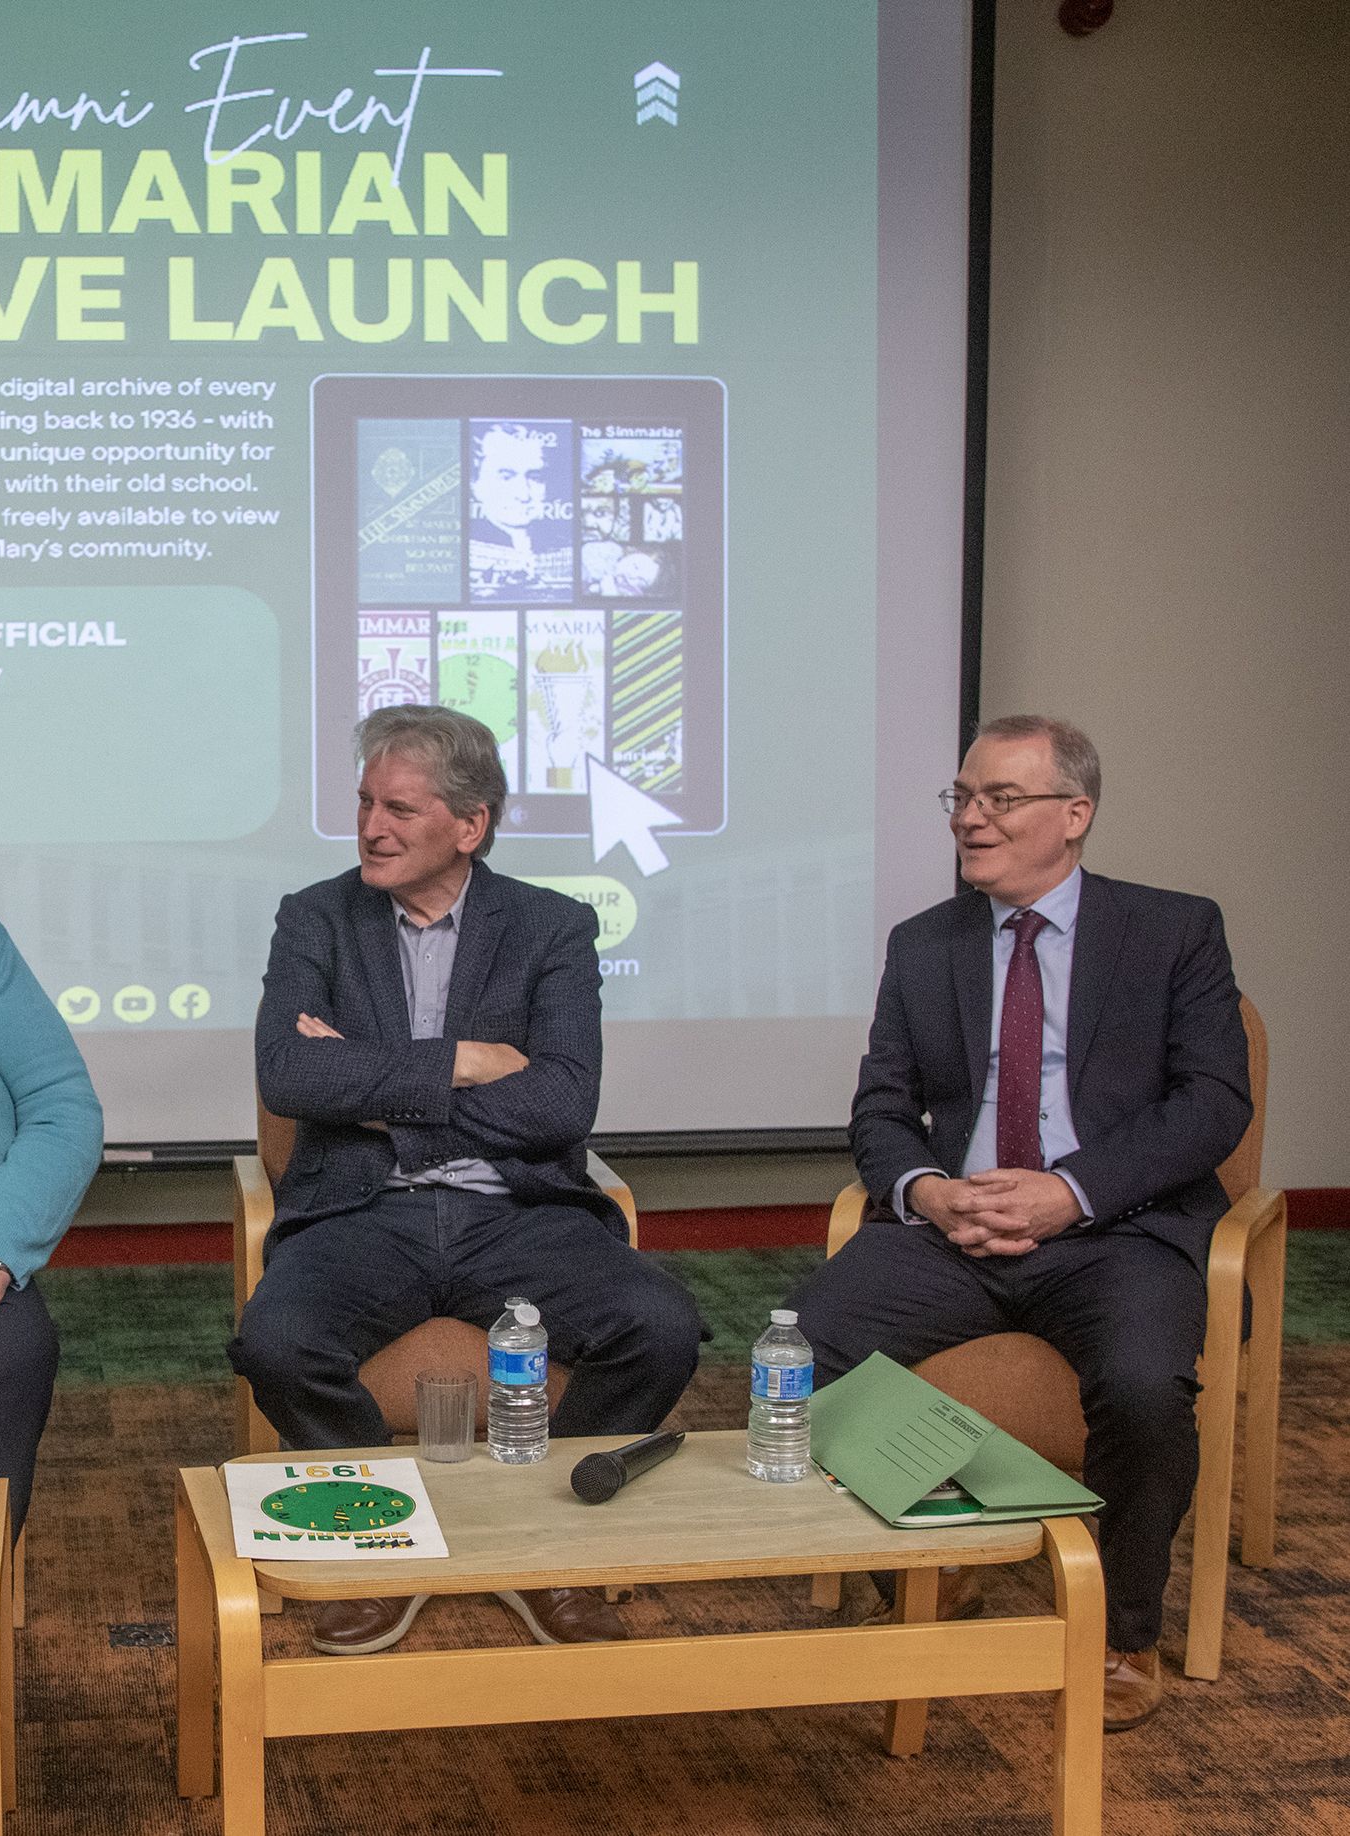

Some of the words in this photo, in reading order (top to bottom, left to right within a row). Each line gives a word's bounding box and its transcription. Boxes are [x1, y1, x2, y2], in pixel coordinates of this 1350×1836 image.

[185, 32, 503, 188] Event
[168, 257, 699, 345] LAUNCH
[0, 377, 75, 400] digital
[81, 377, 172, 396] archive
[177, 377, 202, 396] of
[208, 380, 277, 400] every
[44, 410, 103, 429] back
[109, 412, 134, 429] to
[139, 409, 196, 429] 1936
[220, 410, 274, 429] with
[0, 443, 85, 466] unique
[91, 442, 236, 465] opportunity
[241, 441, 275, 460] for
[5, 473, 58, 493] with
[64, 473, 122, 492] their
[127, 472, 165, 491] old
[171, 472, 259, 492] school.
[2, 507, 71, 530] freely
[77, 506, 186, 526] available
[191, 507, 217, 525] to
[222, 506, 280, 525] view
[68, 538, 213, 560] community.
[568, 892, 621, 907] OUR
[598, 959, 640, 976] om
[284, 1464, 375, 1479] 1991
[253, 1529, 410, 1542] SIMMARIAN
